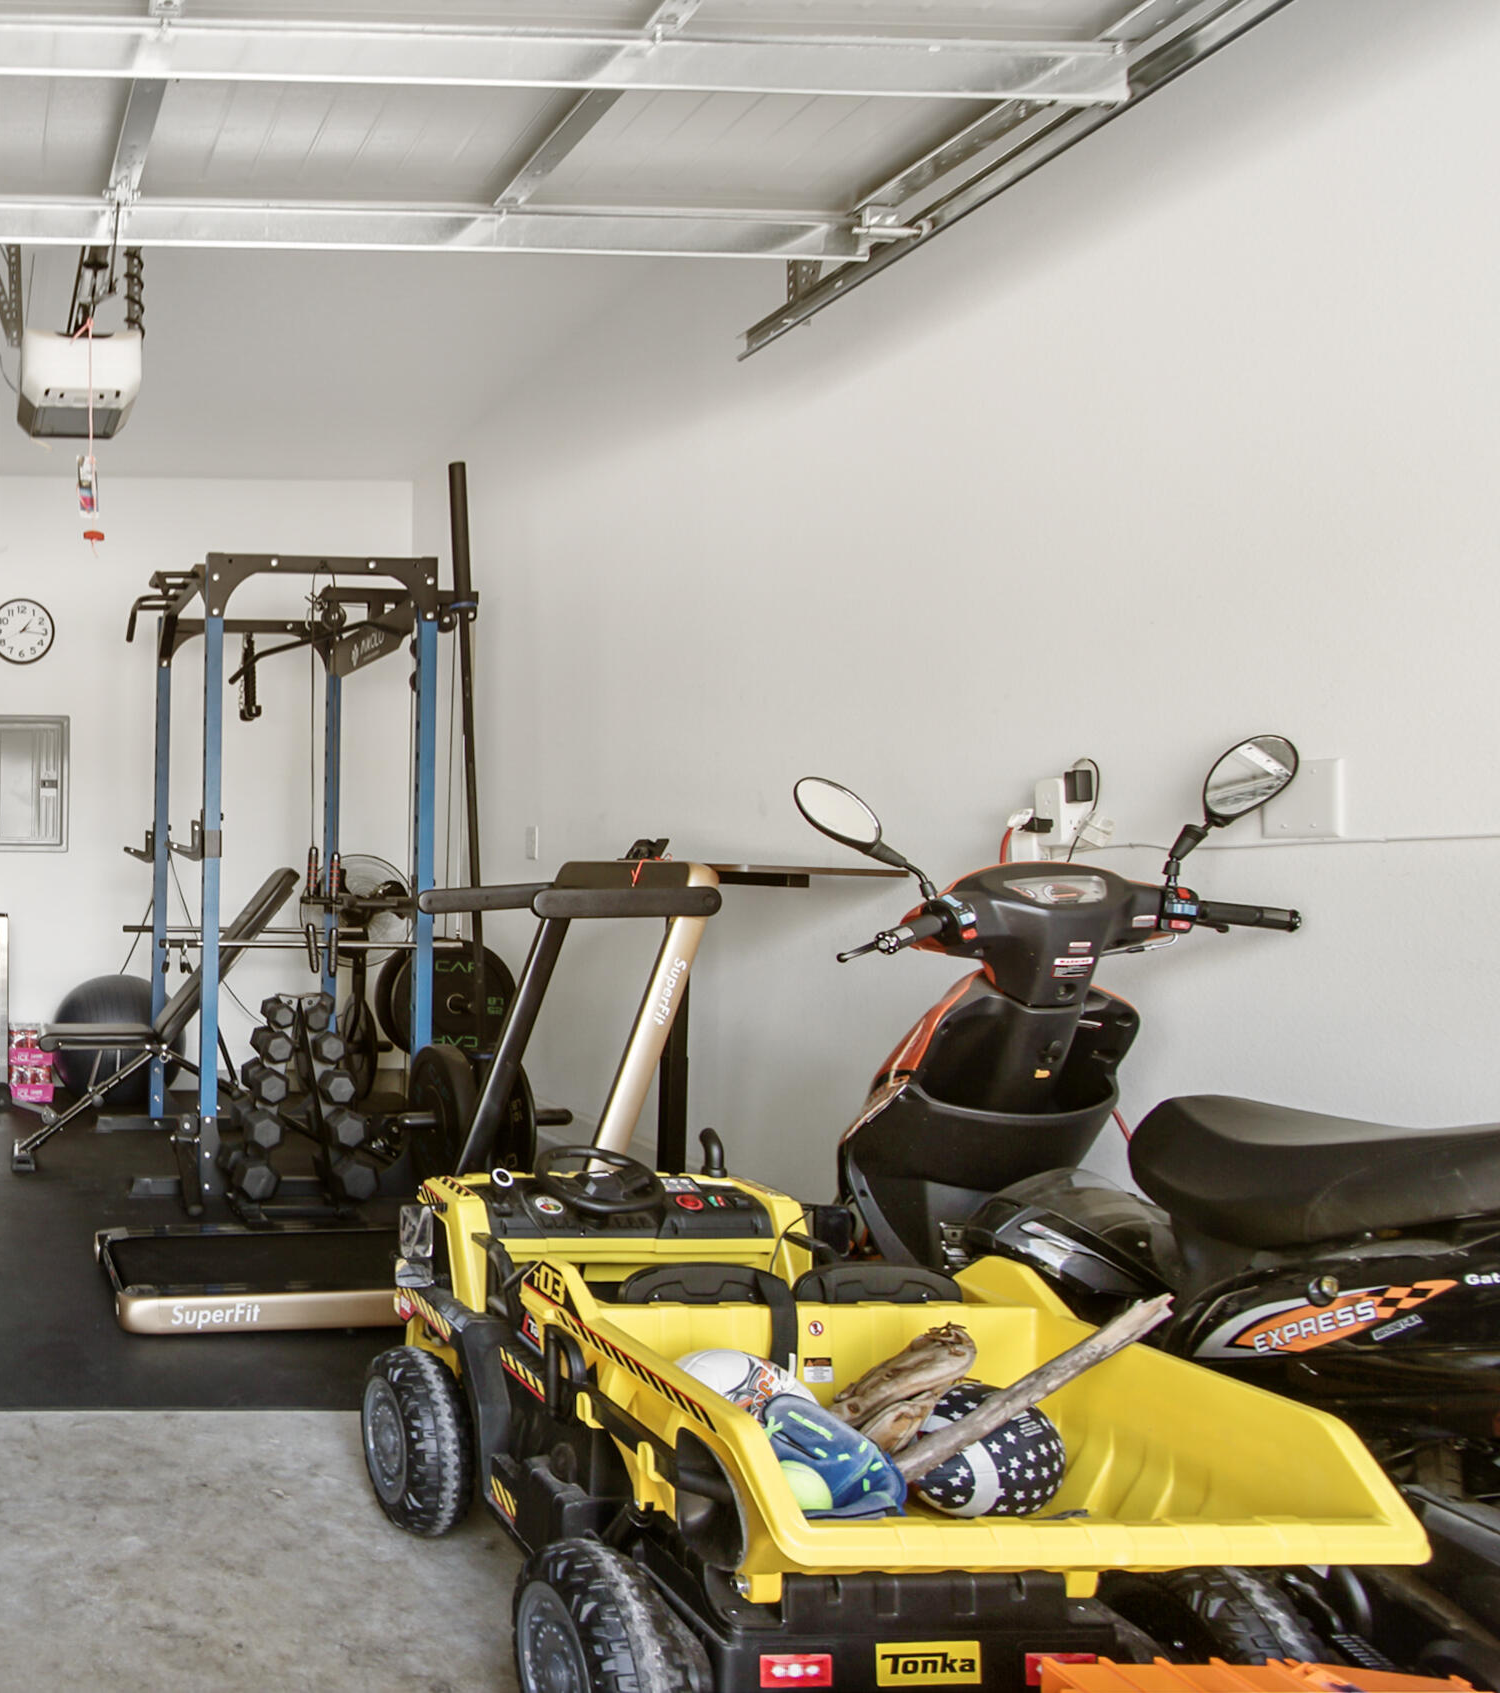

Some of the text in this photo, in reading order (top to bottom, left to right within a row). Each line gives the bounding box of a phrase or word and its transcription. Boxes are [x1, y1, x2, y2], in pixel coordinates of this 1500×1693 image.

[7, 608, 15, 617] 11
[17, 605, 28, 615] 12
[32, 608, 37, 617] 1
[0, 616, 9, 626] 10
[38, 616, 45, 626] 2
[42, 628, 49, 637] 3
[0, 638, 6, 647] 8
[37, 638, 44, 647] 4
[7, 646, 14, 655] 7
[19, 648, 26, 658] 6
[30, 646, 37, 656] 5
[653, 957, 687, 1025] SuperFit
[171, 1302, 261, 1330] SuperFit
[1253, 1300, 1378, 1353] EXPRESS
[880, 1652, 976, 1675] Tonka
